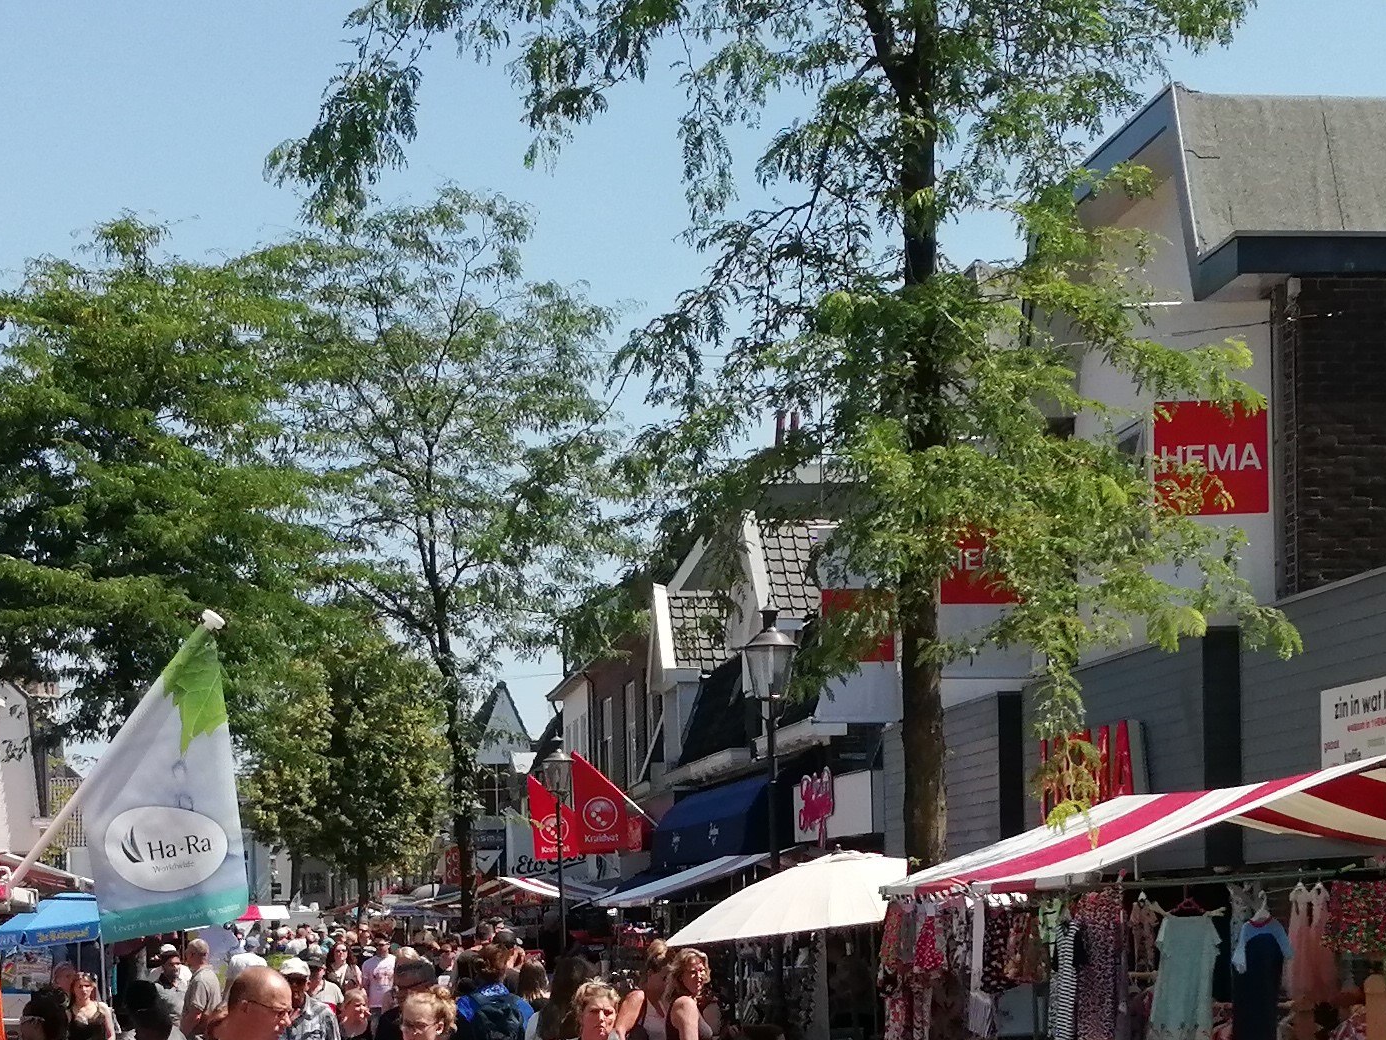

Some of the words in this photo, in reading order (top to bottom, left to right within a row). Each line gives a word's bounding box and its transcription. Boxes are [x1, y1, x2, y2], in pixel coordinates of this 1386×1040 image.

[1334, 696, 1348, 720] zin
[1350, 694, 1360, 716] in
[1362, 690, 1382, 713] wat
